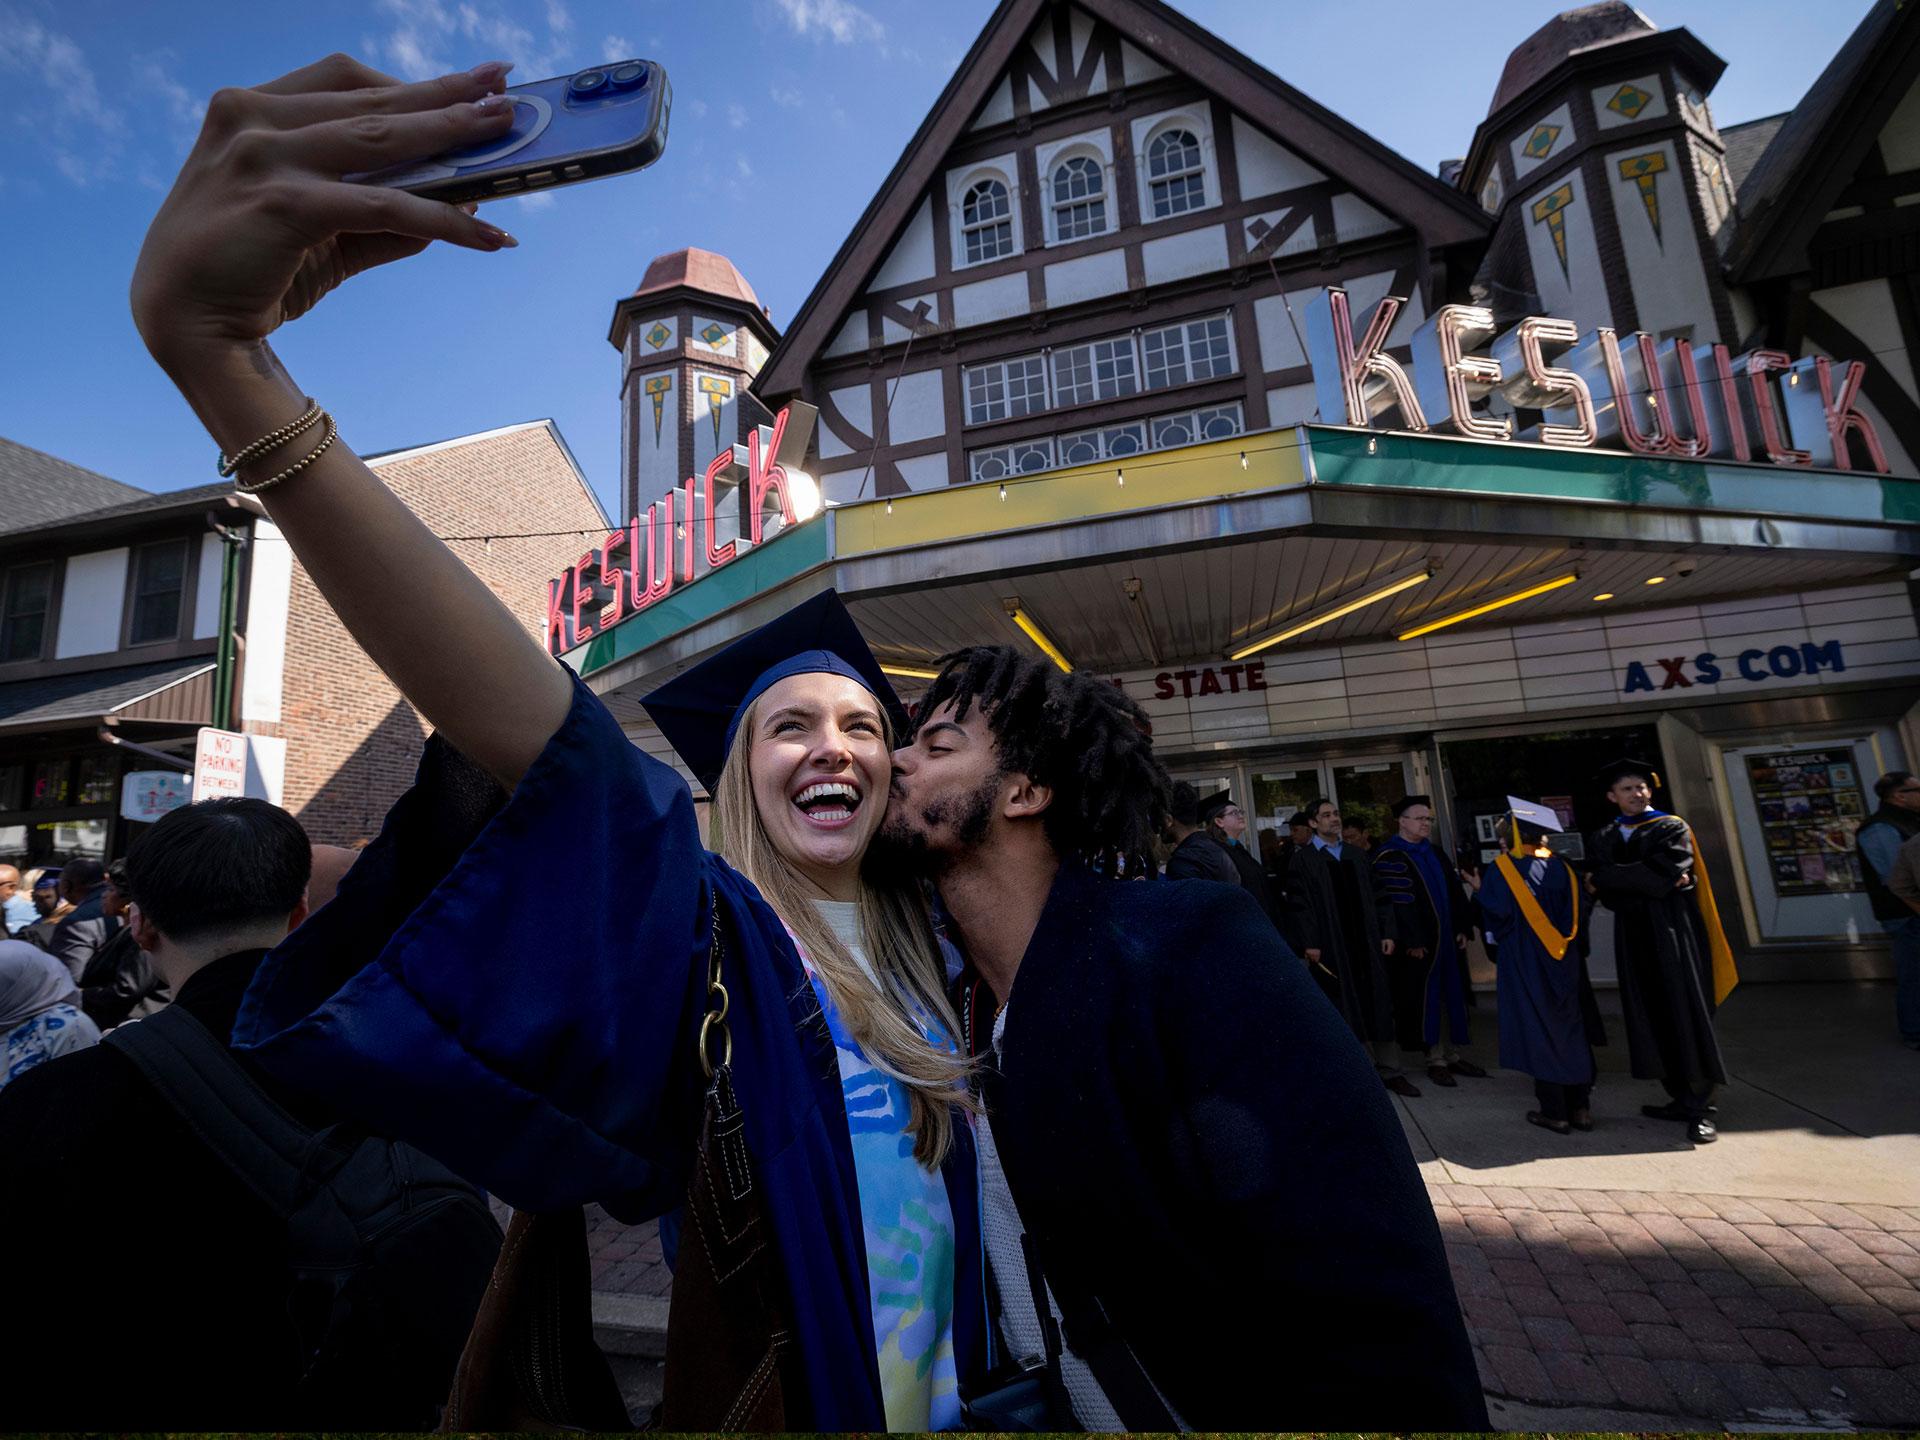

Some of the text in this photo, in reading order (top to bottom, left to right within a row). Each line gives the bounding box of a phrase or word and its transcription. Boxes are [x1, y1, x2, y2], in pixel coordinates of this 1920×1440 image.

[1328, 287, 1892, 474] KESWICK
[547, 406, 798, 655] KESWICK
[1155, 662, 1267, 699] STATE
[1624, 640, 1845, 693] AXS COM
[201, 753, 242, 773] PARKING
[215, 737, 231, 753] NO
[202, 776, 238, 789] BETWEEN
